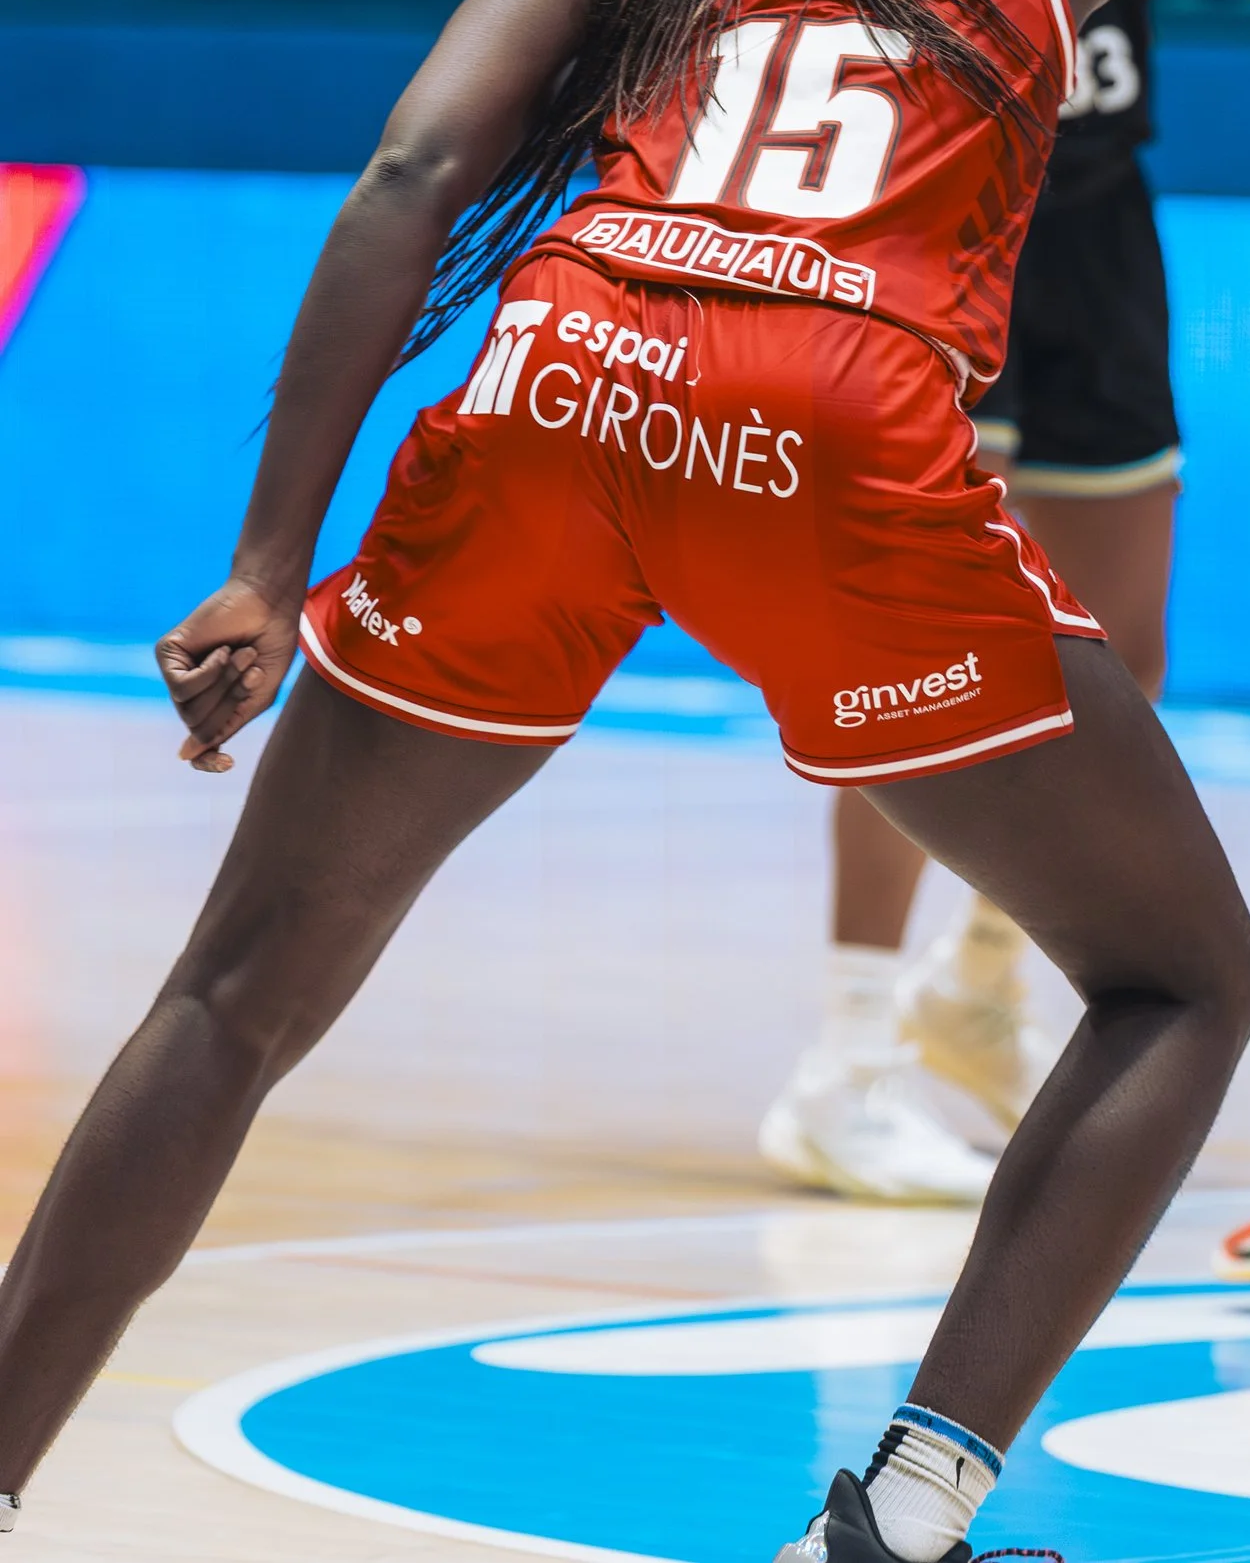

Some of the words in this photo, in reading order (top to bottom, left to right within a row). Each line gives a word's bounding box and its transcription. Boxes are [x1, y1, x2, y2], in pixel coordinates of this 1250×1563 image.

[666, 14, 914, 219] 15
[580, 222, 872, 305] BAUHAUS
[556, 310, 689, 382] espai
[528, 362, 804, 499] GIRONÈS
[833, 651, 983, 728] ginvest
[876, 708, 910, 722] ASSET
[912, 687, 983, 716] MANAGEMENT
